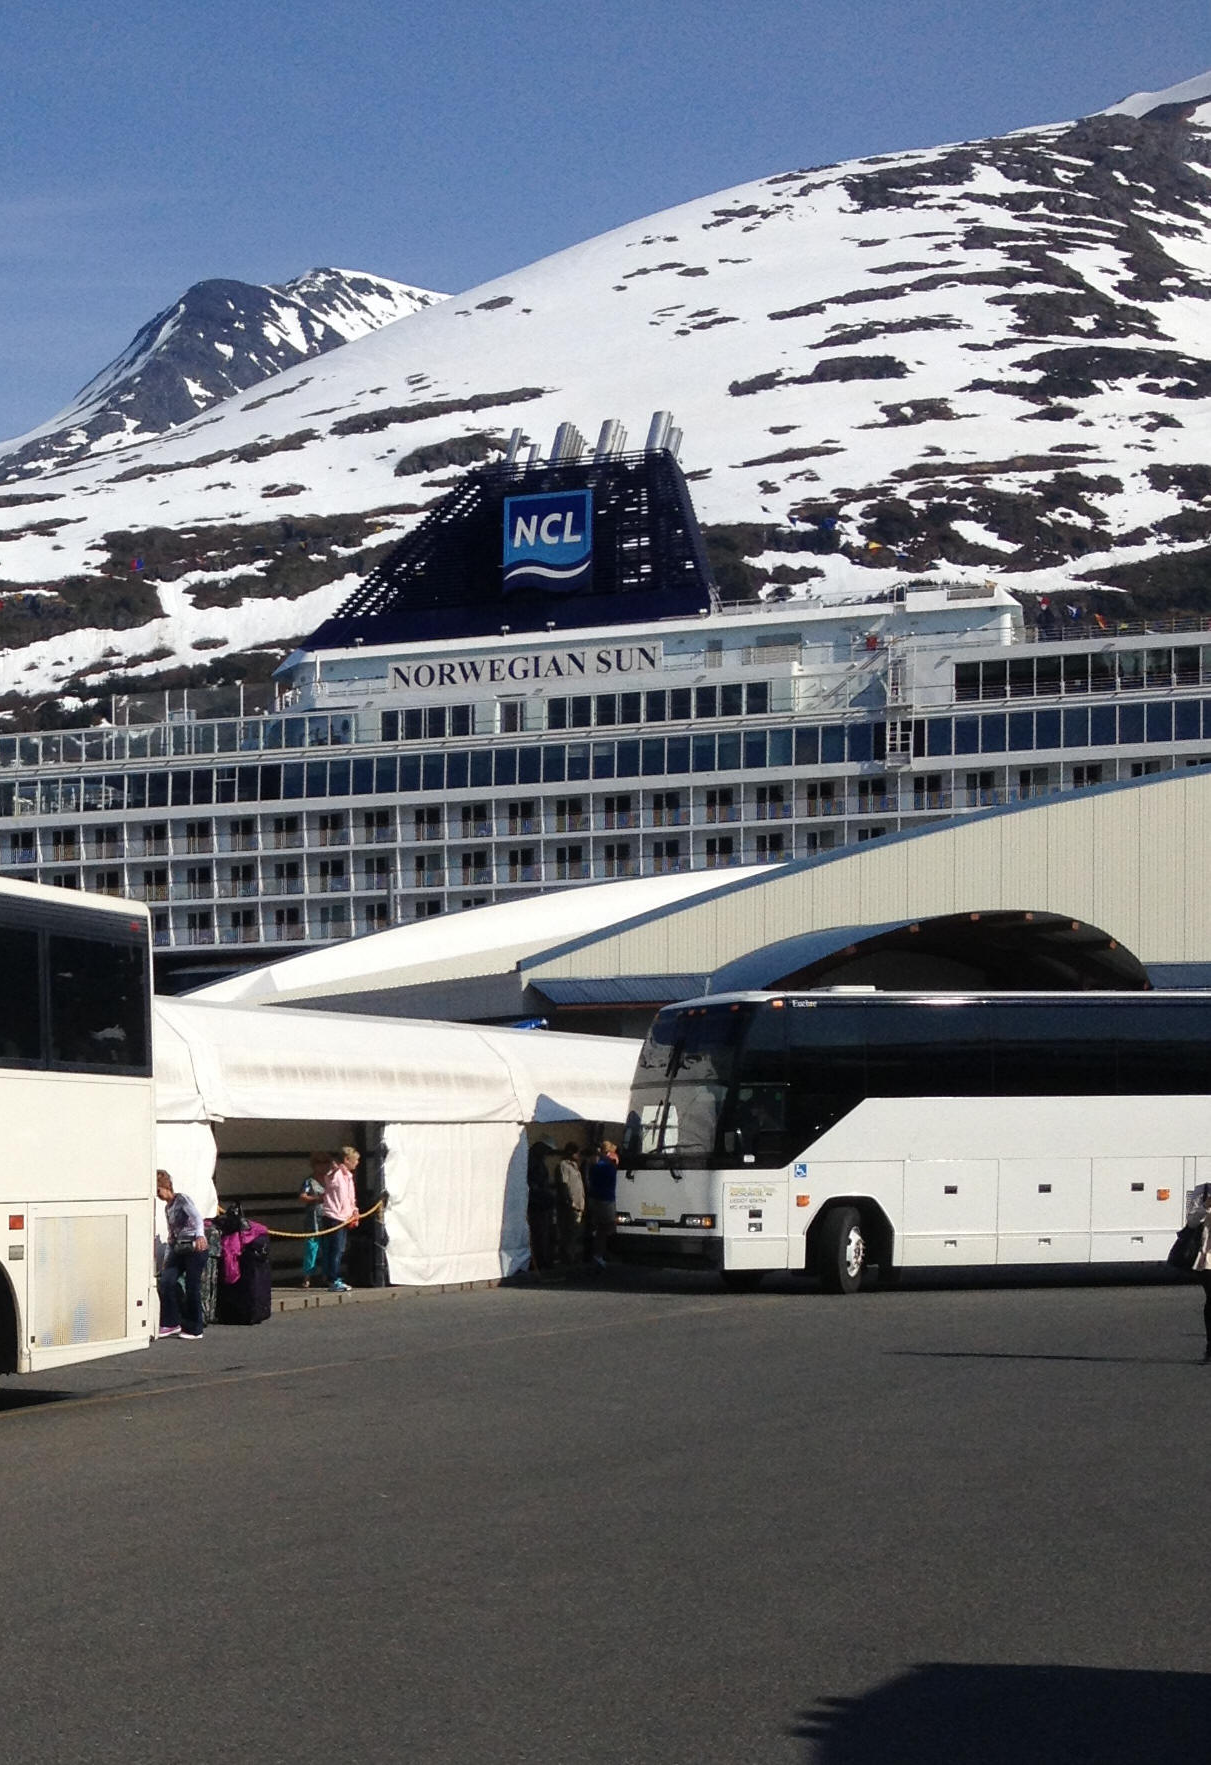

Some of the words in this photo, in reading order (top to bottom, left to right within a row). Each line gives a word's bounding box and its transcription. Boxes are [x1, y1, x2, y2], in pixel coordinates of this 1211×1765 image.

[513, 511, 582, 548] NCL
[391, 651, 586, 690] NORWEGIAN
[596, 646, 658, 675] SUN
